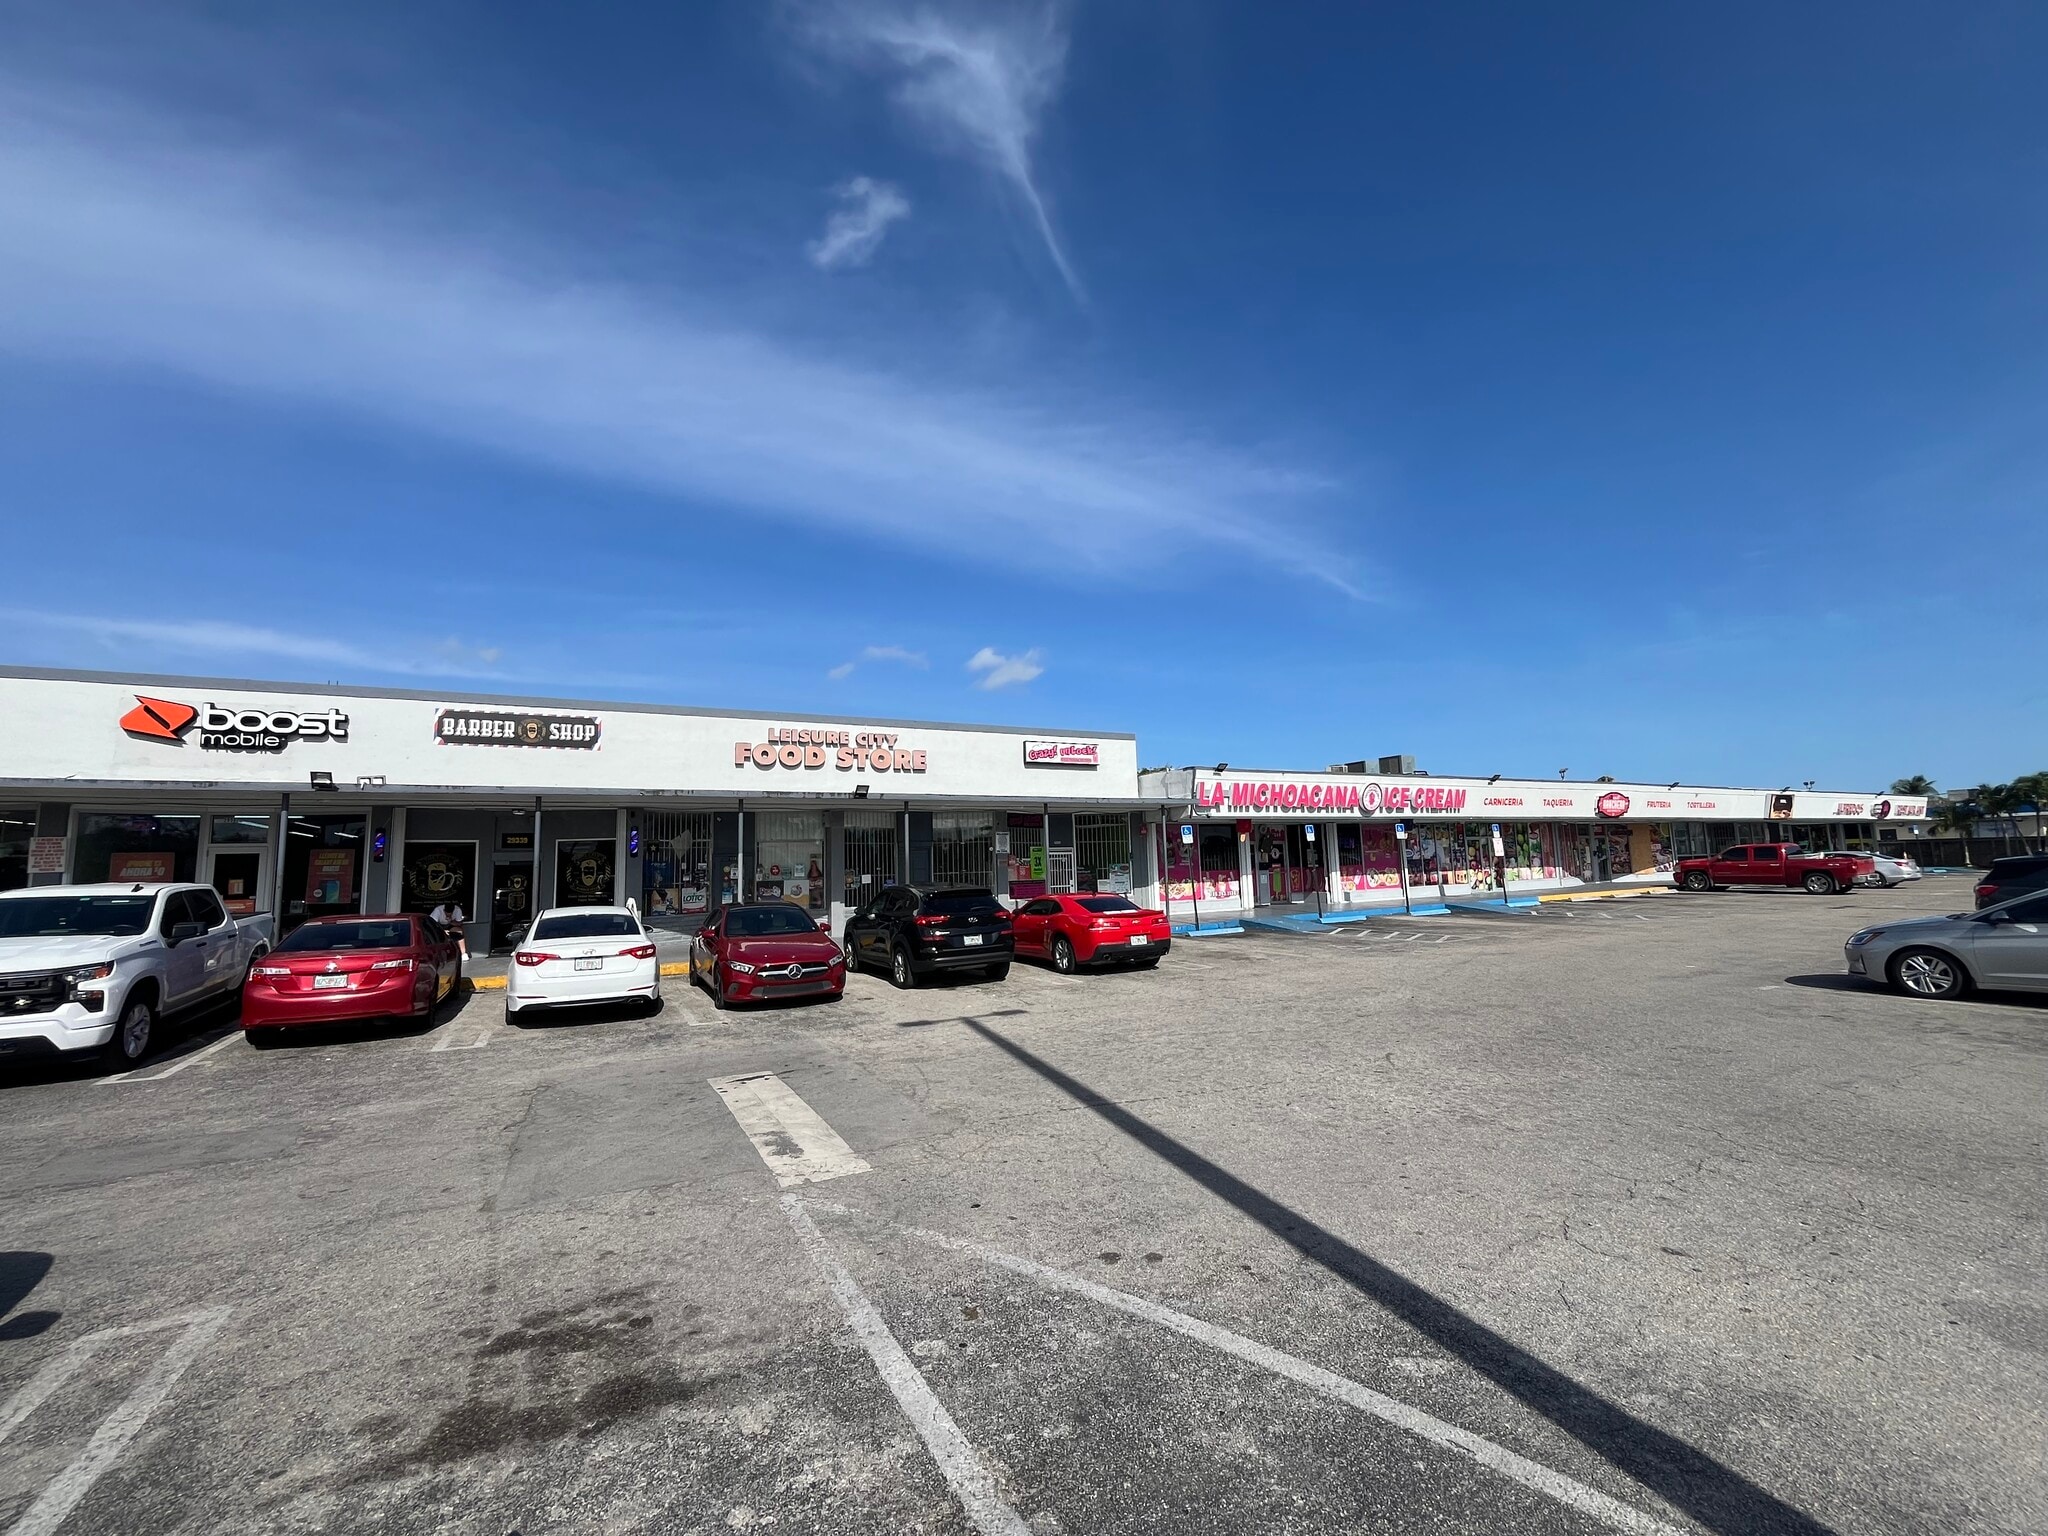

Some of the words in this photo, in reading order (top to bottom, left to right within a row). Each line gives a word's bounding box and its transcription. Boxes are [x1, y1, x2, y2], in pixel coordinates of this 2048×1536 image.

[202, 702, 346, 735] boost
[442, 717, 516, 739] BARBER
[549, 723, 596, 742] SHOP
[767, 727, 850, 746] LEISURE
[855, 732, 898, 749] CITY
[201, 733, 280, 747] mobile
[735, 742, 827, 770] FOOD
[836, 747, 927, 773] STORE
[1197, 782, 1225, 806] LA
[1230, 782, 1361, 808] MICHOACANA
[1381, 786, 1411, 808] ICE
[1411, 787, 1467, 809] CREAM
[1483, 797, 1524, 807] CARNICERIA
[1543, 798, 1573, 808] TAQUERIA
[1646, 800, 1672, 809] FRUTERIA
[1686, 801, 1716, 809] TORTILLERIA
